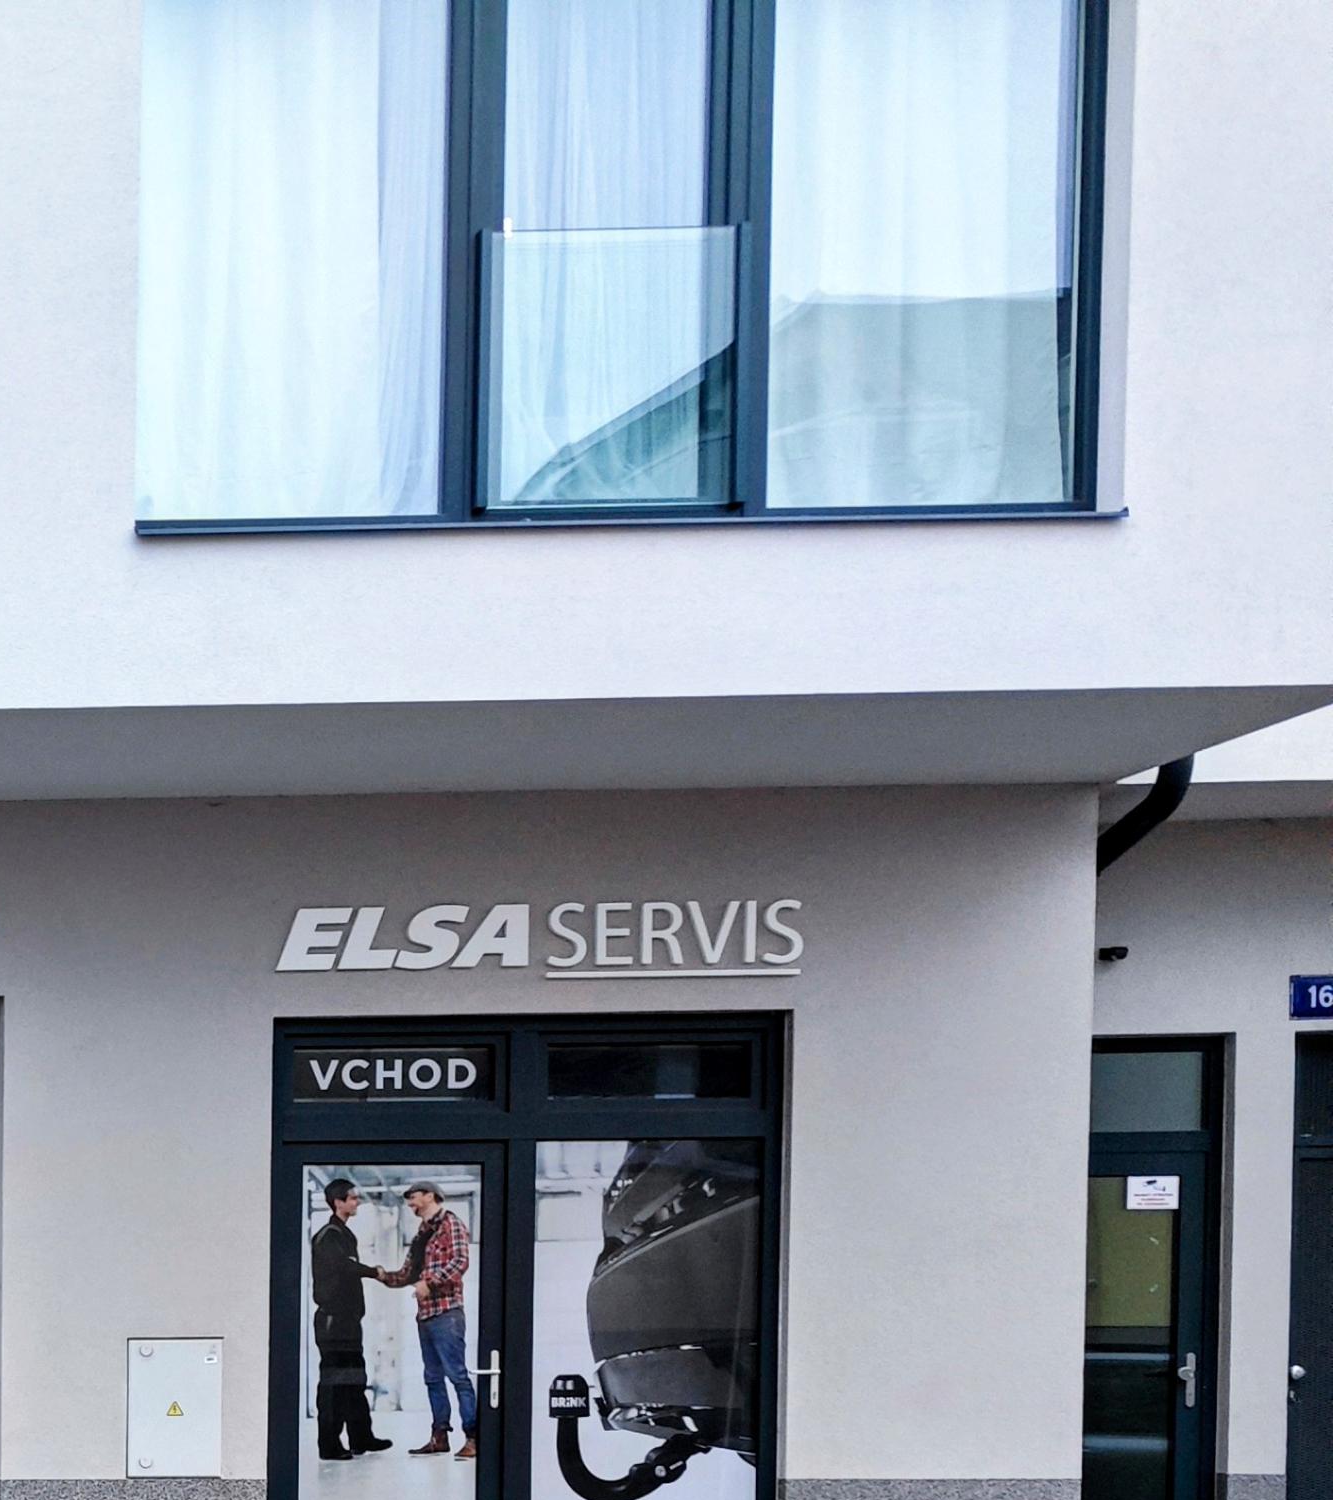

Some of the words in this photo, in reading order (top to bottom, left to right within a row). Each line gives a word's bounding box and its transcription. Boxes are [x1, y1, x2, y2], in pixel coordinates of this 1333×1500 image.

[274, 903, 530, 972] ELSA
[544, 899, 805, 968] SERVIS
[309, 1058, 477, 1090] VCHOD
